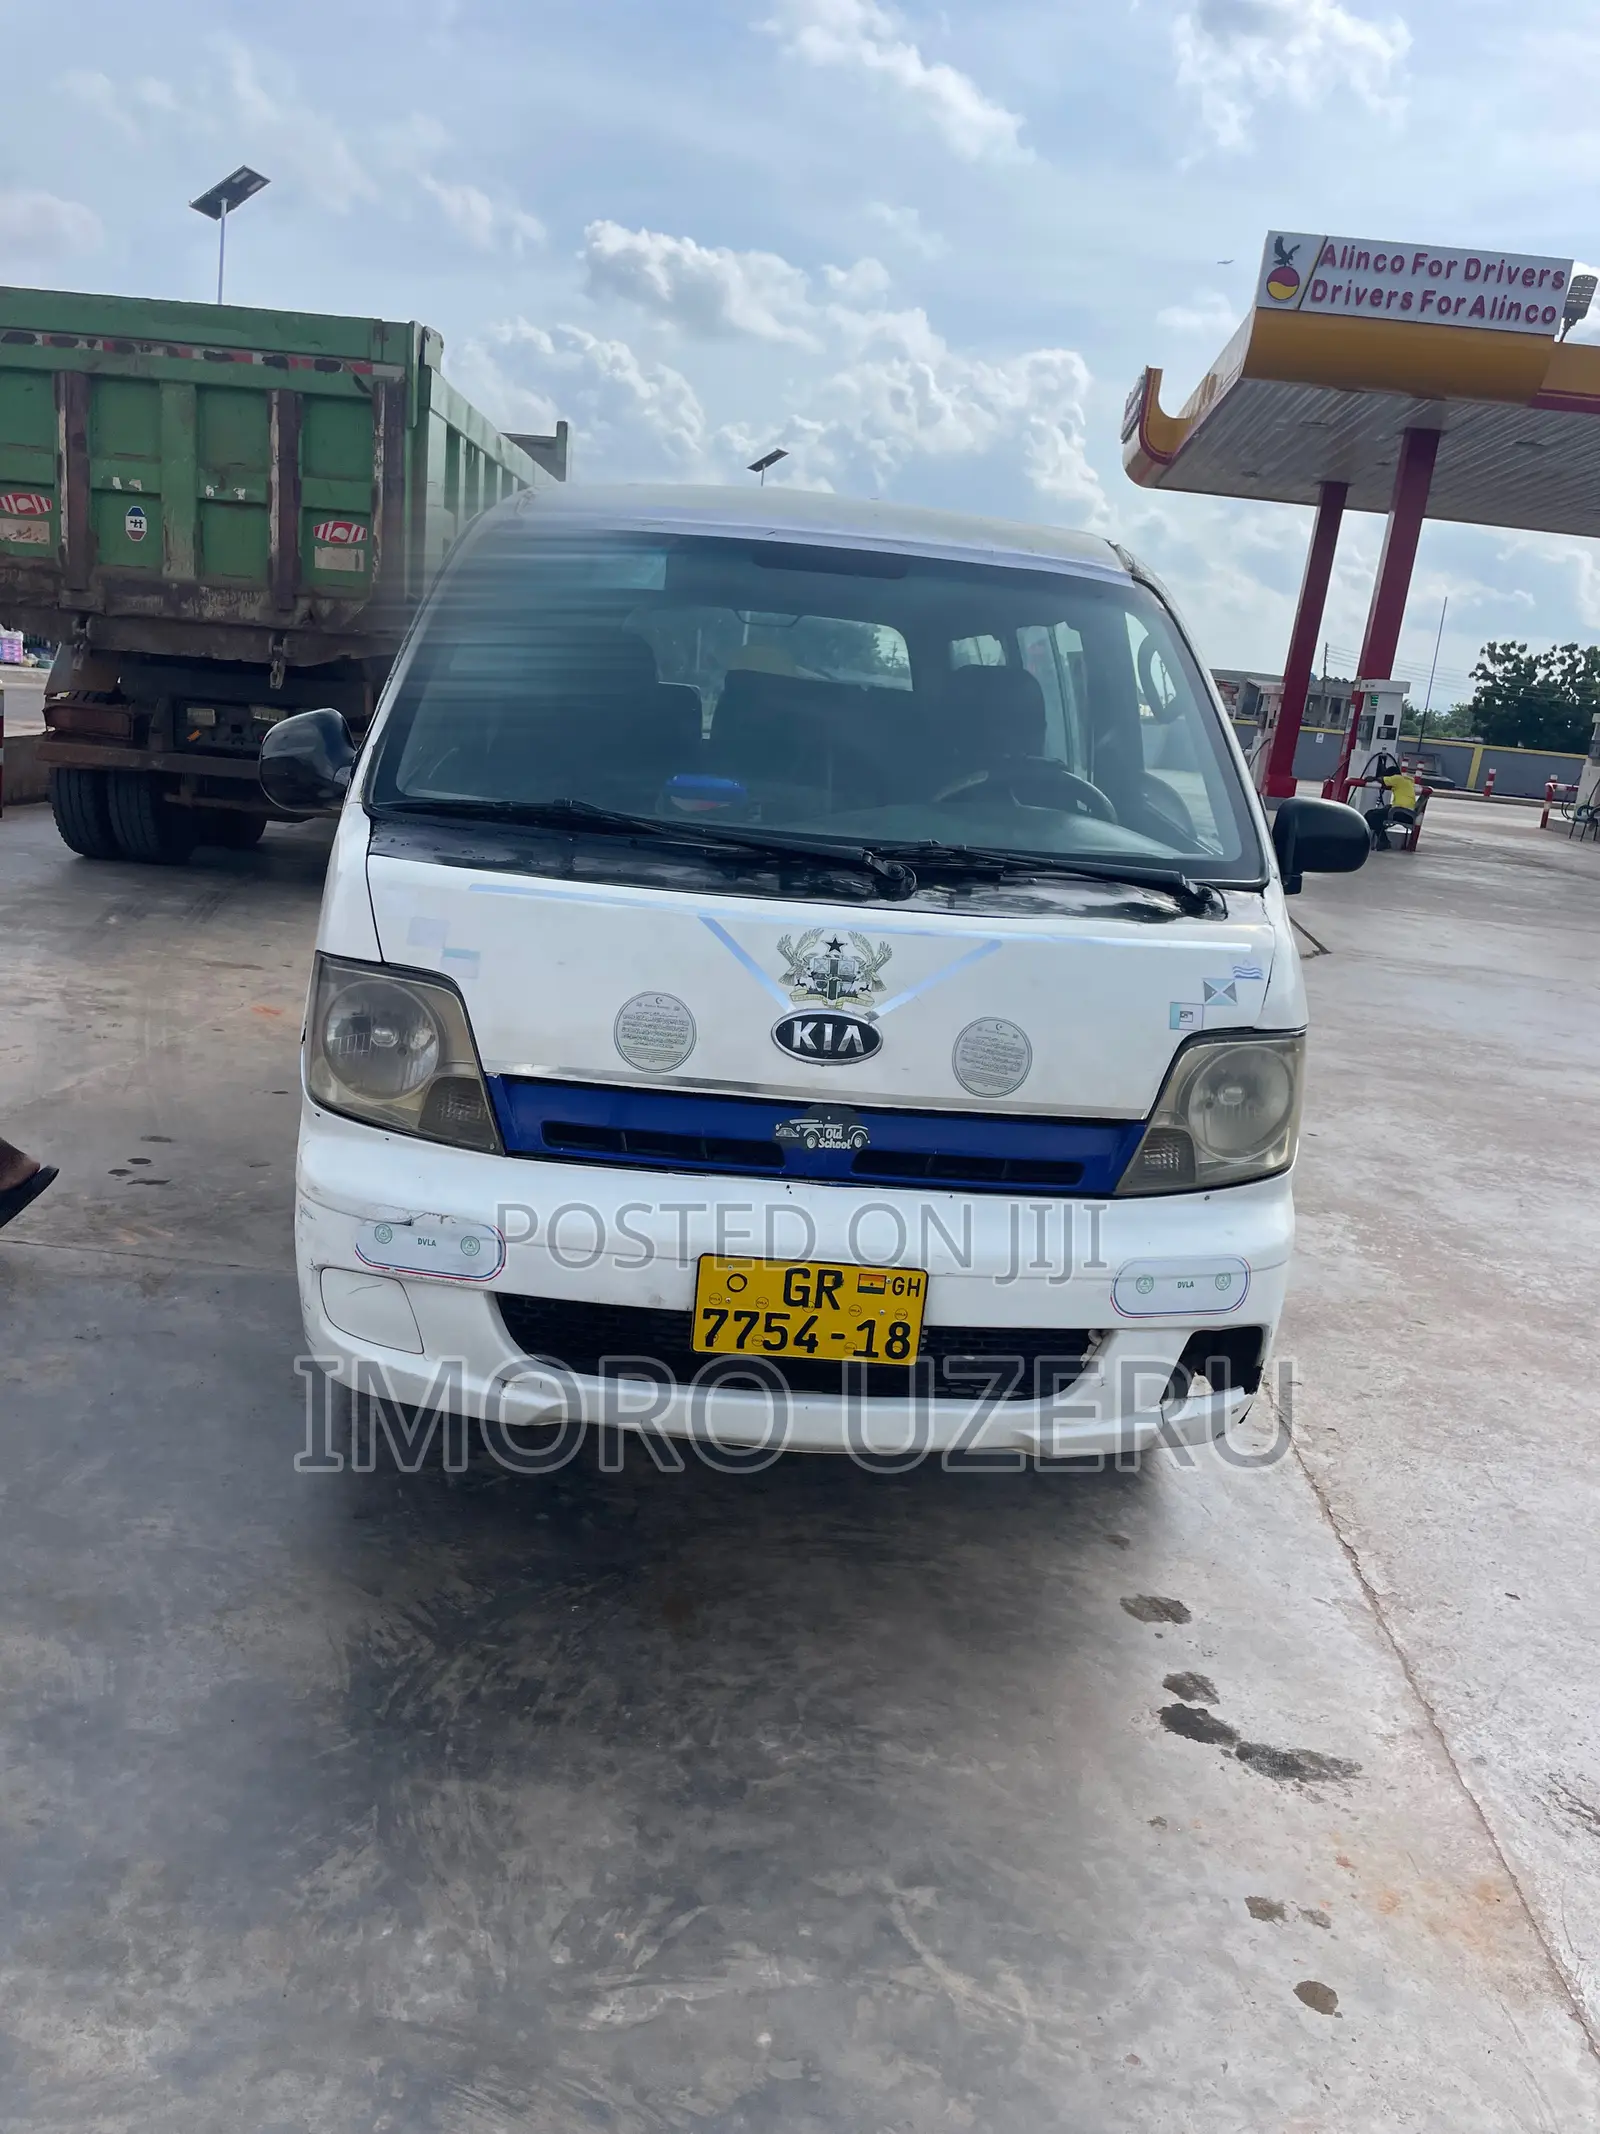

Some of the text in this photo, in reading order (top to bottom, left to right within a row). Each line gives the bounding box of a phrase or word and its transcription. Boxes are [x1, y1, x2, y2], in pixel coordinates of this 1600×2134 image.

[1320, 244, 1565, 289] Alinco For Drivers
[1310, 279, 1556, 324] Drivers For Alinco
[792, 1020, 864, 1053] KIA
[818, 1138, 851, 1149] School
[825, 1128, 843, 1139] Old
[417, 1237, 436, 1247] DVLA
[783, 1267, 921, 1310] GR GH
[1177, 1280, 1194, 1289] DVLA
[702, 1308, 911, 1360] 7754-18
